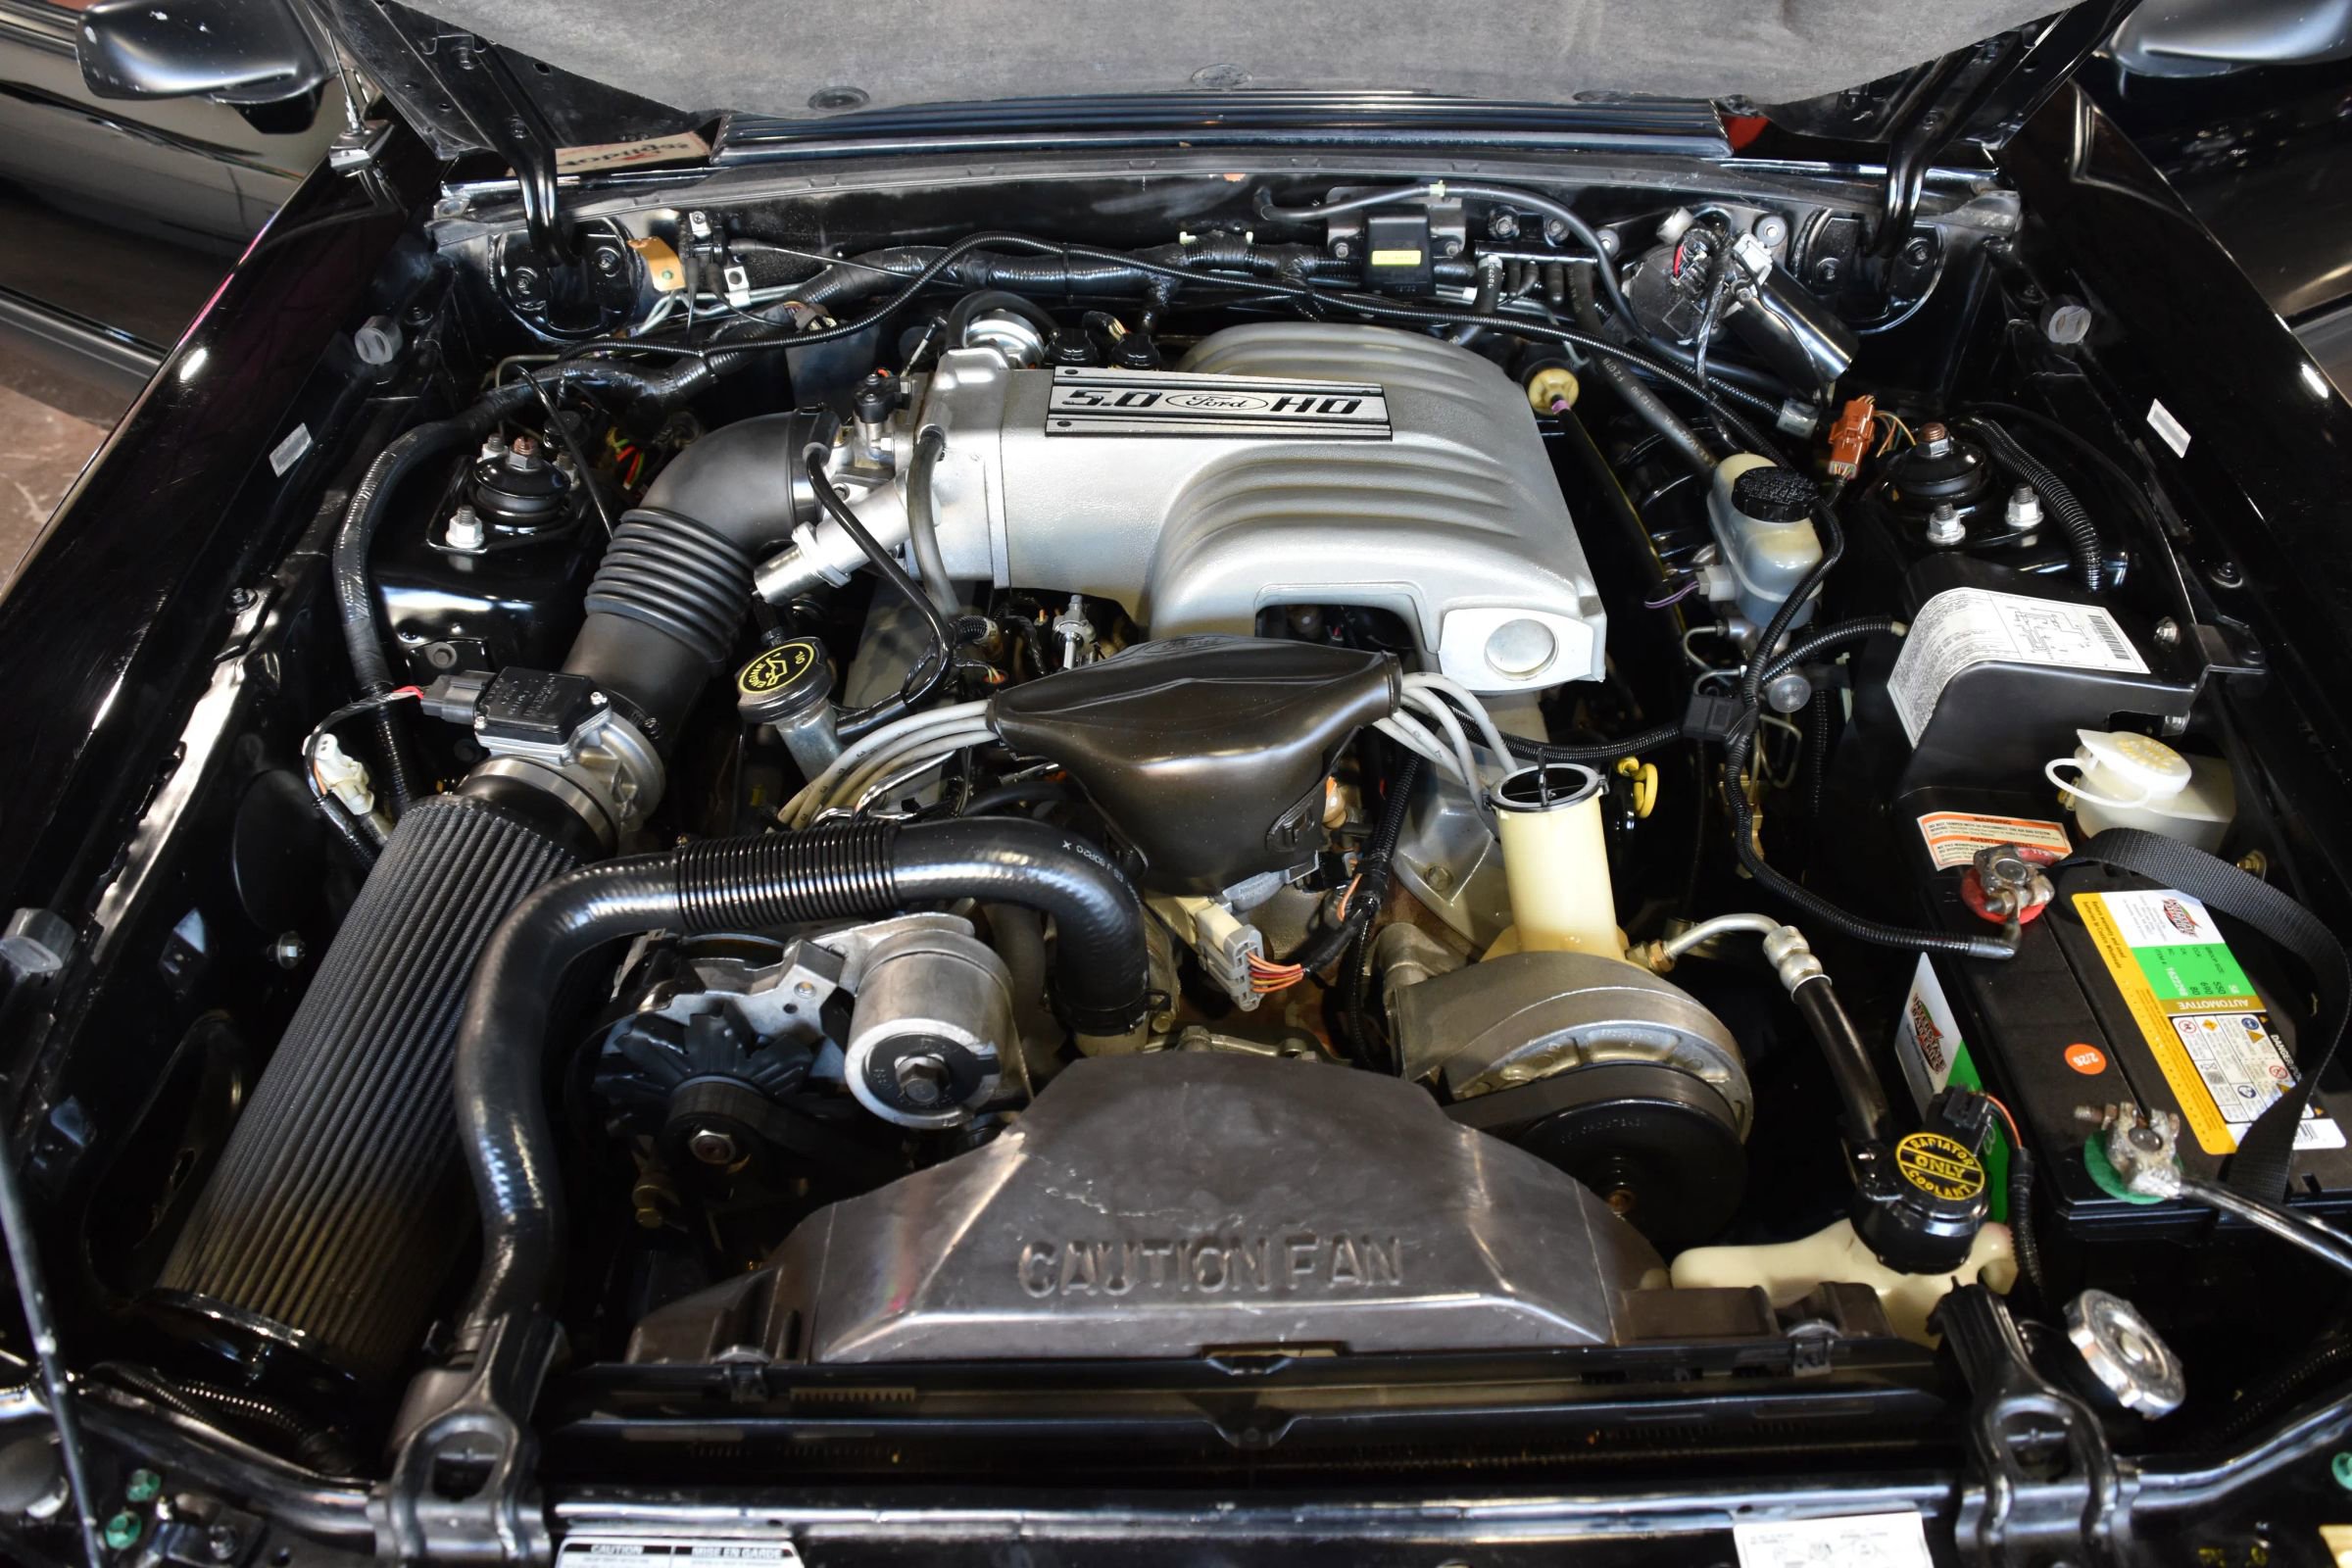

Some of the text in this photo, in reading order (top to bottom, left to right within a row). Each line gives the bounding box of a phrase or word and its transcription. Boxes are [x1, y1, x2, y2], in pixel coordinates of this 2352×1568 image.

[1061, 389, 1363, 415] 5.0 Ford HO
[795, 651, 806, 664] OIL
[748, 663, 766, 688] ENGINE
[2200, 982, 2213, 995] 690
[2213, 981, 2226, 994] 550
[2177, 999, 2248, 1009] AUTOMOTIVE
[1910, 1138, 1975, 1165] RADIATOR
[1915, 1154, 1966, 1178] ONLY
[1909, 1169, 1971, 1197] COOLANT
[1018, 1233, 1402, 1298] CAUTION FAN
[591, 1544, 643, 1554] CAUTION
[692, 1546, 782, 1559] MISE EN GARDE
